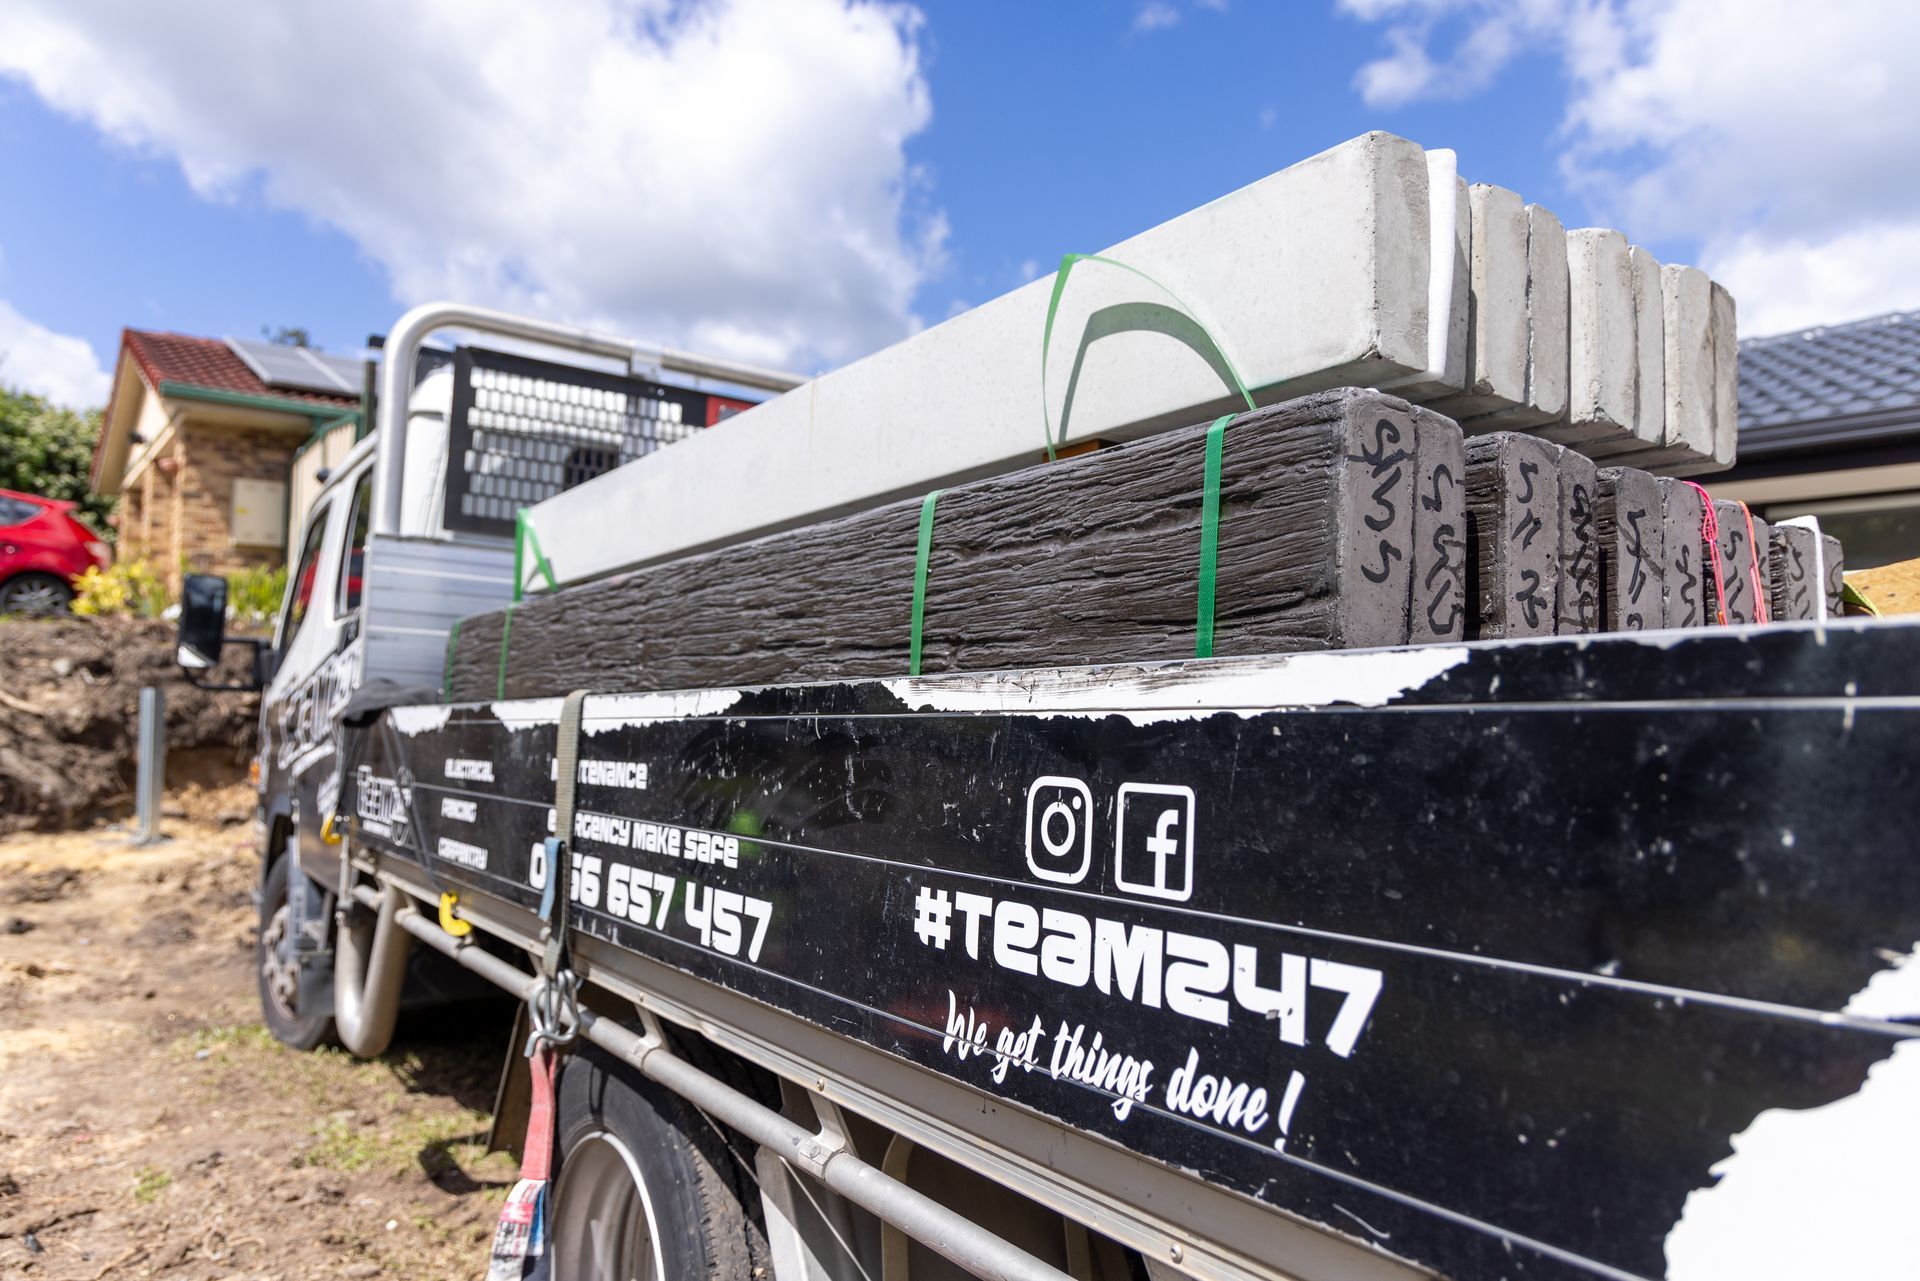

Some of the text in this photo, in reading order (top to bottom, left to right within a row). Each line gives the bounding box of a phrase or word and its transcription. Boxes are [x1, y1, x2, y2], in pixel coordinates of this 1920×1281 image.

[551, 758, 648, 790] TeNaNCe
[607, 862, 676, 931] 657
[684, 881, 773, 963] 457
[942, 990, 988, 1061] We
[991, 1014, 1046, 1084] get
[1050, 1020, 1155, 1121] things
